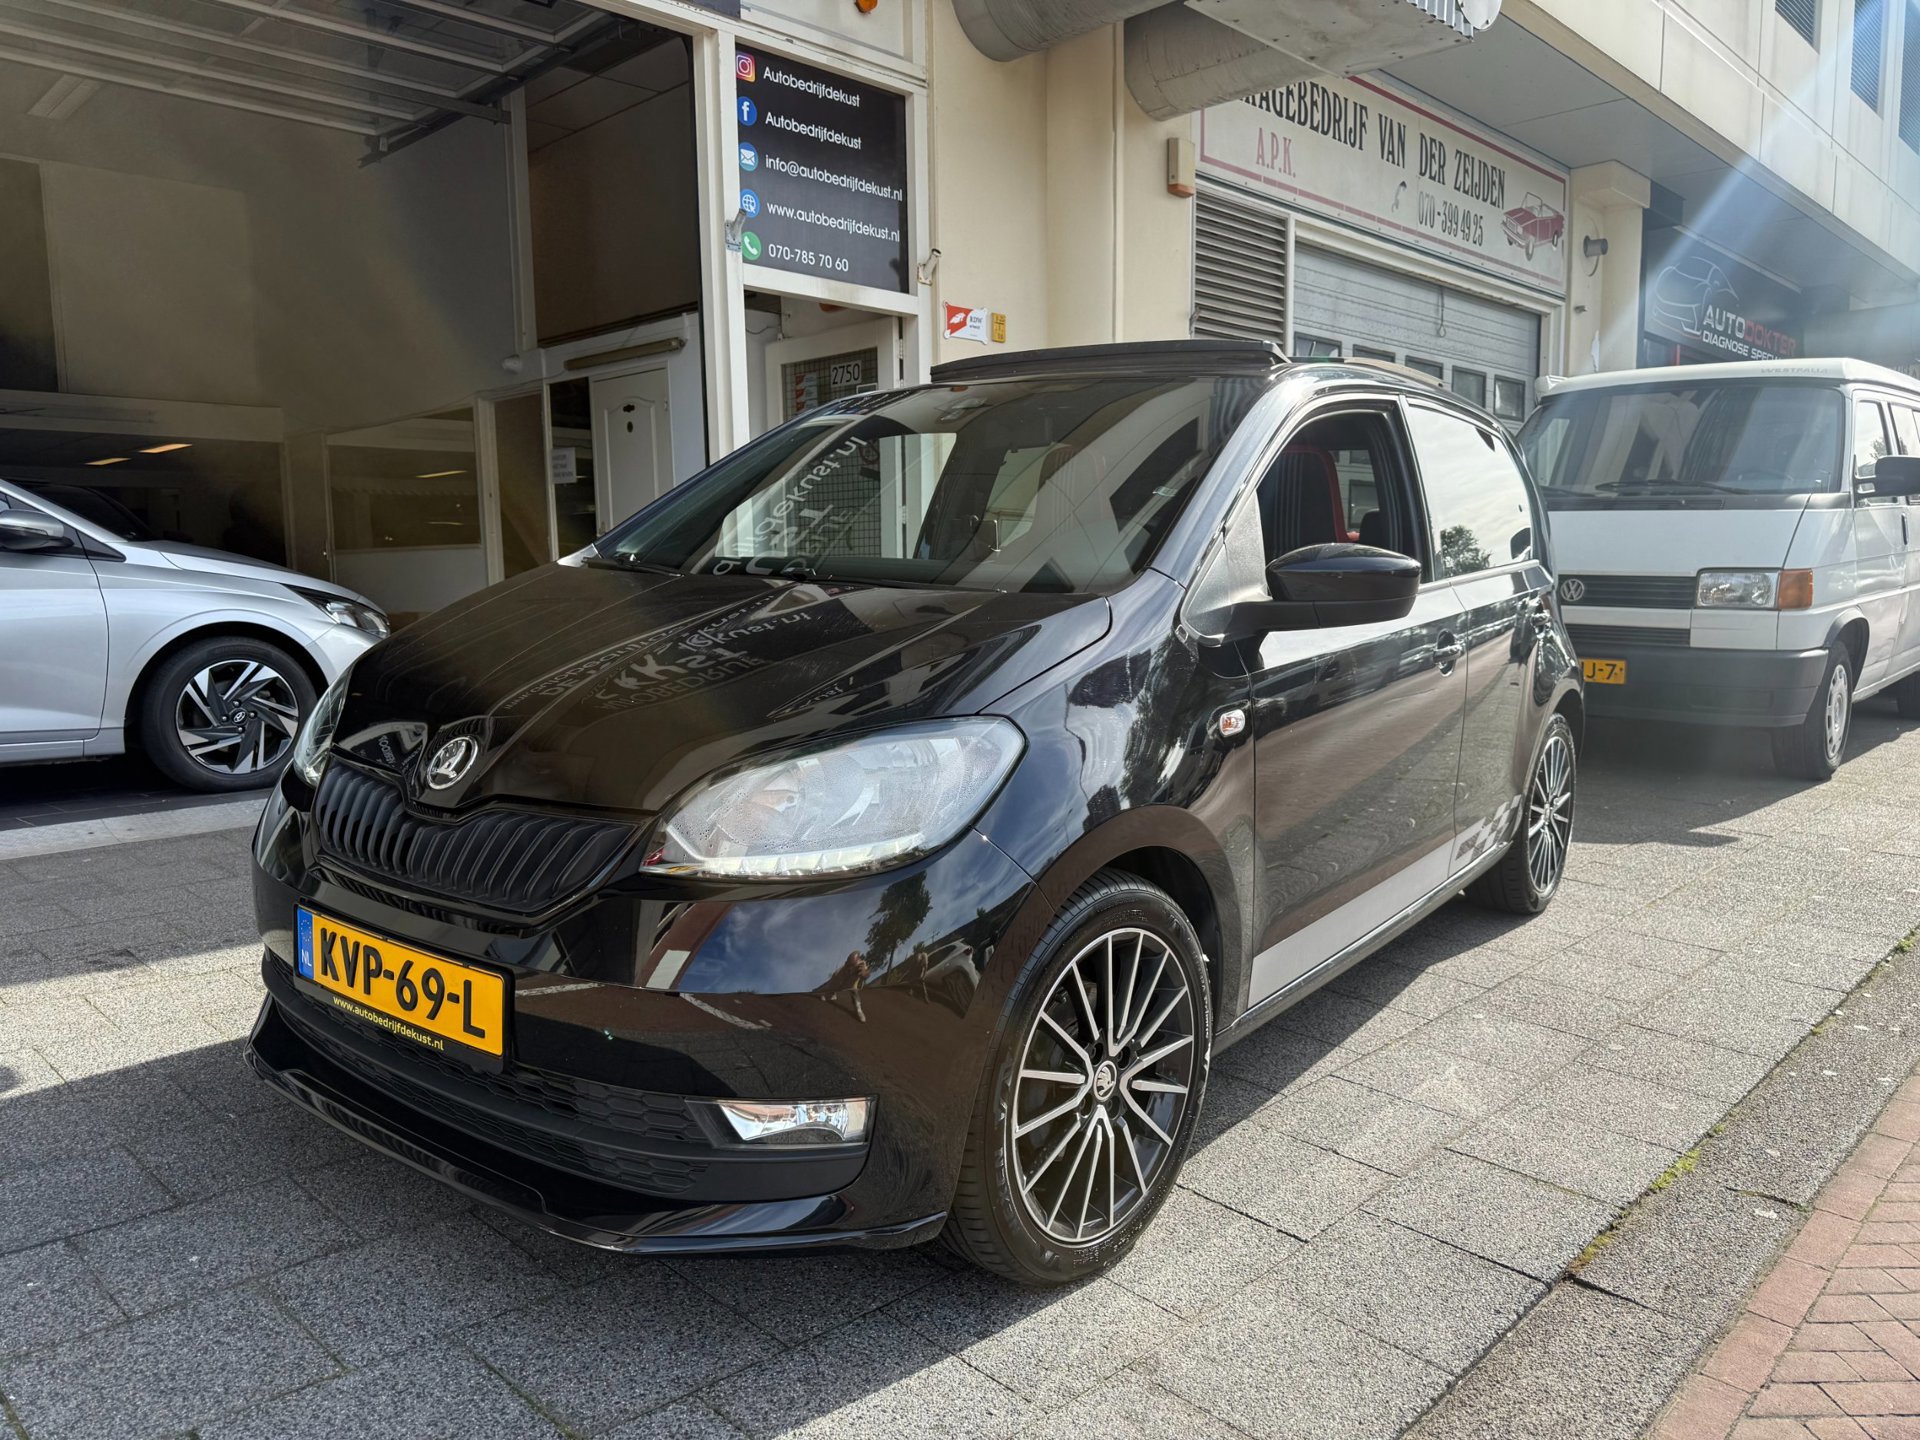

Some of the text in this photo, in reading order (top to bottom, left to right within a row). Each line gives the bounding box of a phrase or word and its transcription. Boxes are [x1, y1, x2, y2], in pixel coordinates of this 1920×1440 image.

[763, 66, 860, 107] Autobedrijfdekust
[765, 111, 862, 150] Autobedrijfdekust
[1256, 127, 1297, 178] A.P.K.
[1378, 113, 1407, 168] VAN
[1418, 132, 1446, 186] DER
[1454, 148, 1506, 210] ZEIJDEN
[765, 154, 902, 202] info@autobedrijfdekust.nl
[767, 201, 900, 243] www.autobedrijfdekust.nl
[768, 243, 849, 272] 070-785 70 60
[1702, 330, 1750, 357] DIAGNOSE
[832, 362, 861, 385] 2750
[301, 949, 313, 967] NL
[320, 927, 486, 1039] KVP-69-L
[333, 996, 444, 1051] www.autobedrijfdekust.nl
